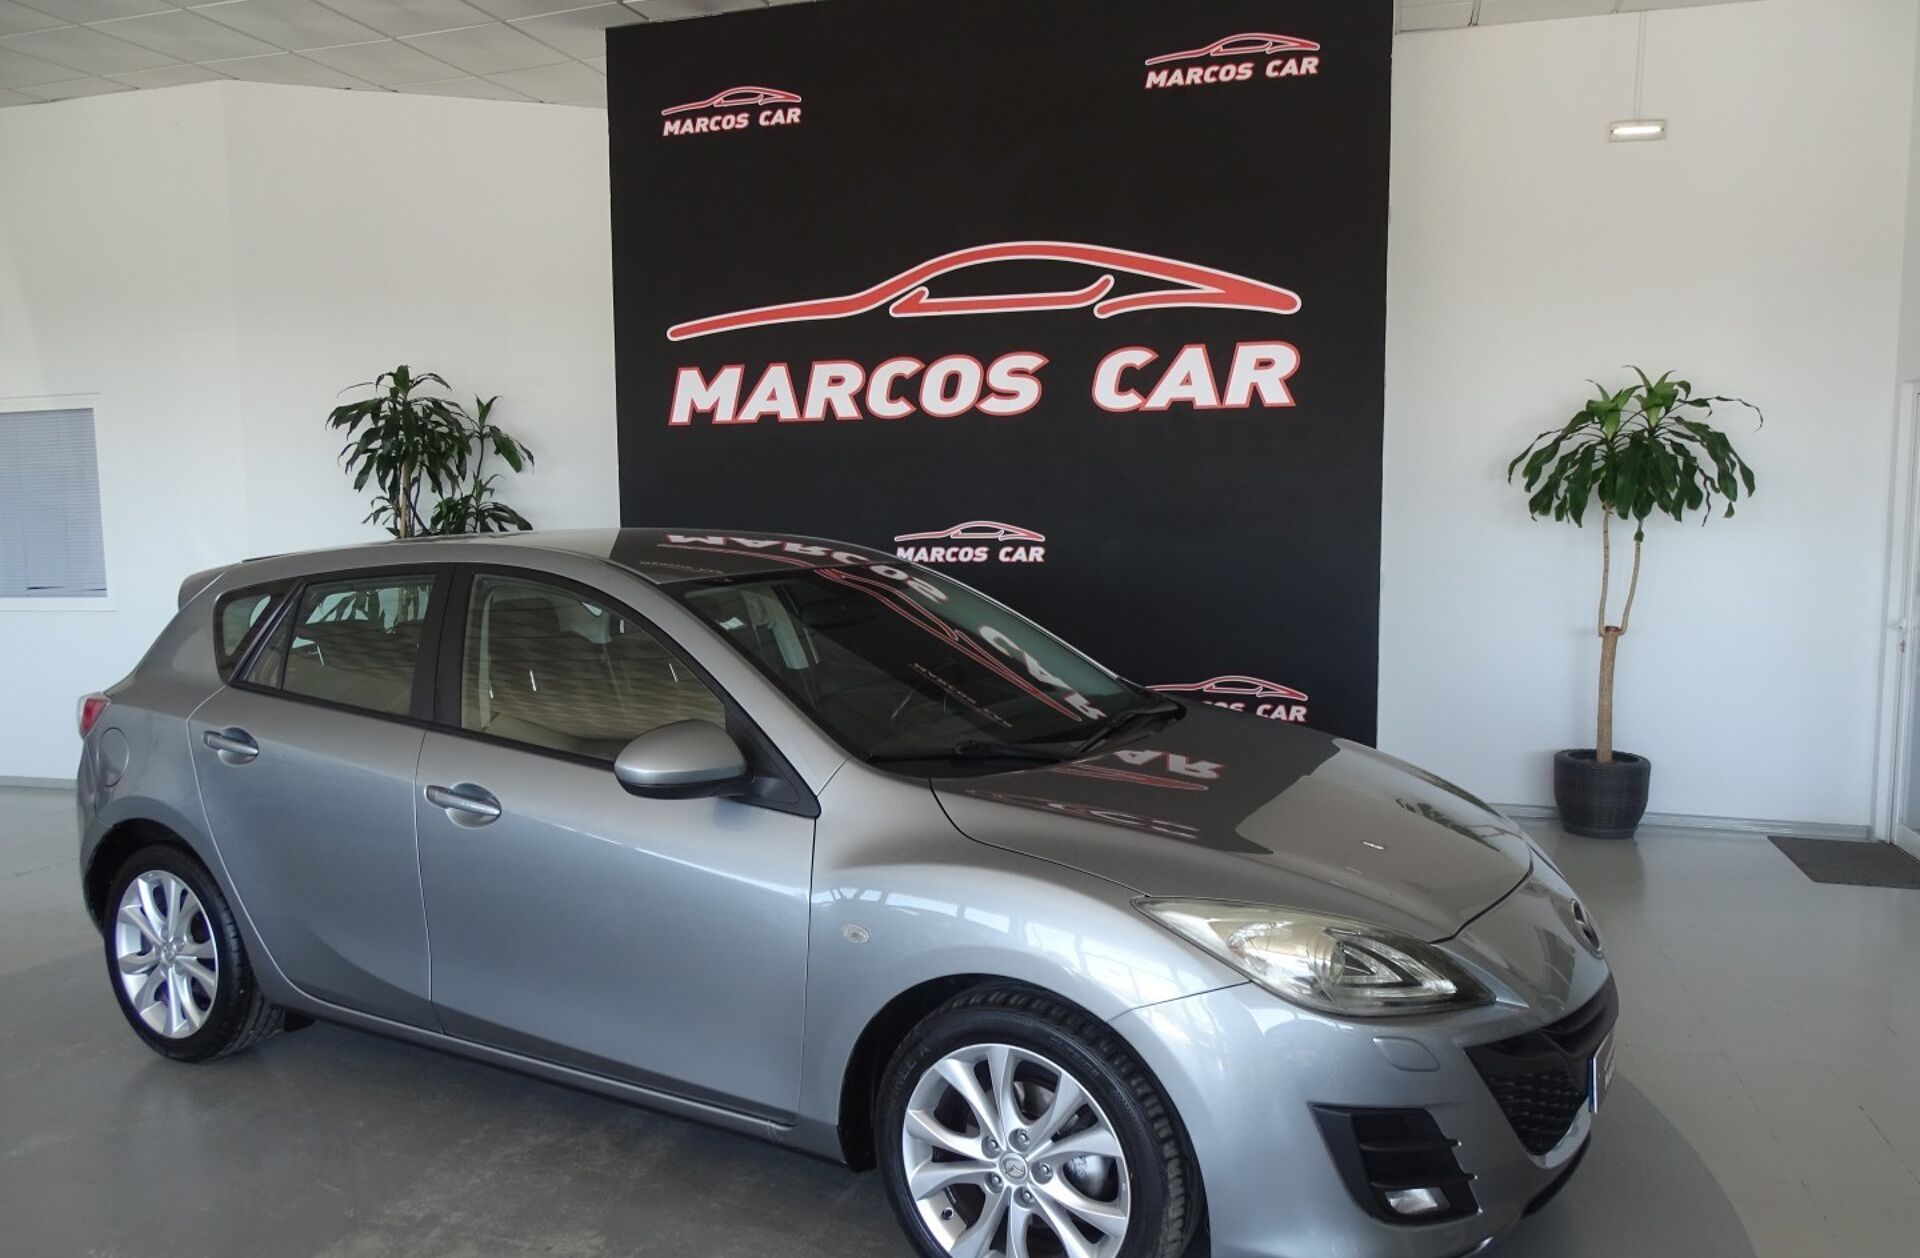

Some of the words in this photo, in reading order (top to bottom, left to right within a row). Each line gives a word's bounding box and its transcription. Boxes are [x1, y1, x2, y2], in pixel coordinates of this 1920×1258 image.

[1144, 62, 1255, 89] MARCOS
[1264, 56, 1320, 78] CAR
[662, 112, 750, 137] MARCOS
[758, 107, 802, 127] CAR
[668, 351, 1049, 426] MARCOS
[1091, 340, 1300, 412] CAR
[896, 546, 990, 563] MARCOS
[998, 546, 1046, 563] CAR
[1256, 704, 1308, 722] CAR
